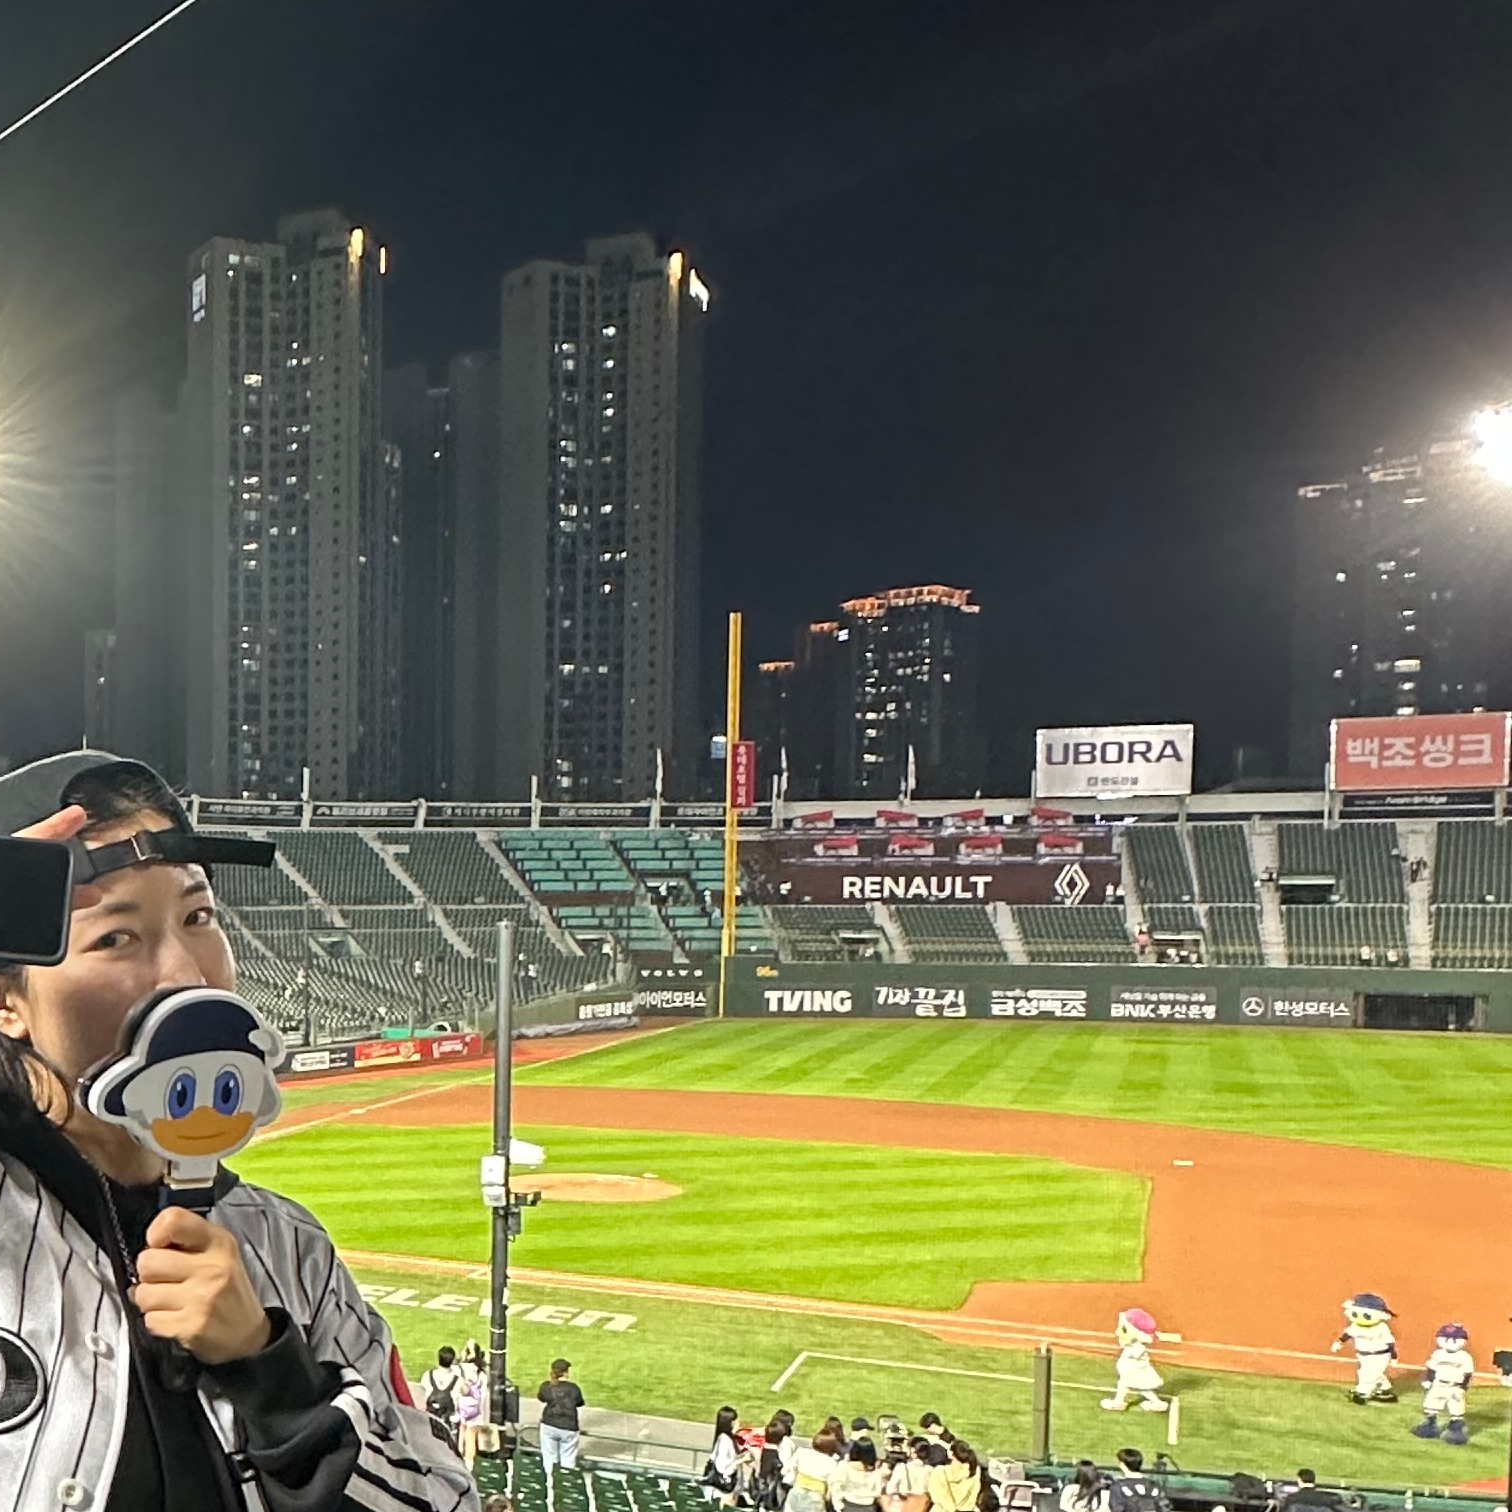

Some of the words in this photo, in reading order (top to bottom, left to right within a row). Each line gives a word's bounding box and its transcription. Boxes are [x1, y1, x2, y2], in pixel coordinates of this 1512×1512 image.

[1045, 740, 1183, 765] UBORA
[1346, 732, 1493, 769] 백조씽크
[842, 875, 992, 899] RENAULT
[764, 989, 853, 1013] TVING
[991, 998, 1086, 1018] 금성백조
[1110, 1002, 1156, 1018] BNK
[1156, 1003, 1216, 1020] 부산은행
[1273, 1000, 1351, 1018] 한성모터스
